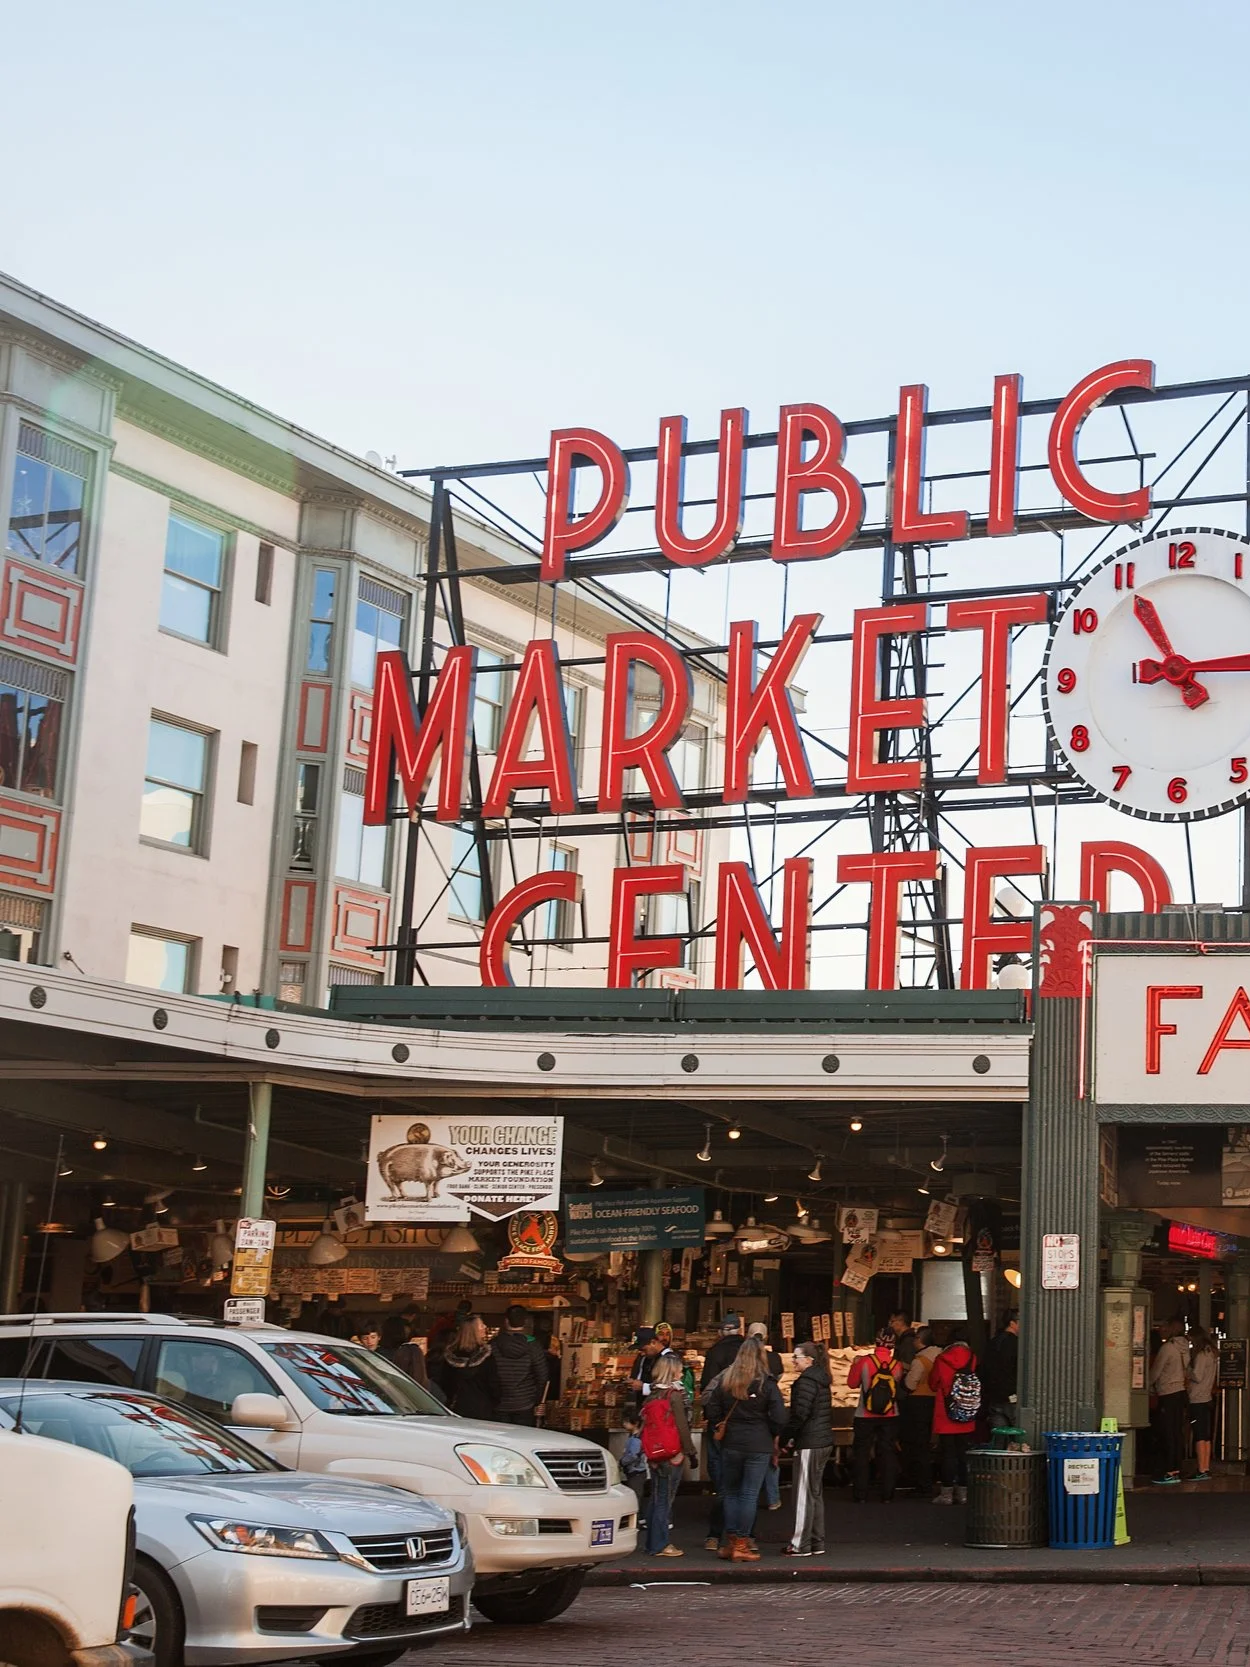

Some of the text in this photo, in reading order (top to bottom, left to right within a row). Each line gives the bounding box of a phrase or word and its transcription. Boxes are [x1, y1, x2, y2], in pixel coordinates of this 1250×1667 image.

[540, 359, 1156, 582] PUBLIC
[1168, 542, 1197, 570] 12
[1234, 553, 1243, 579] 1
[1114, 562, 1135, 590] 11
[1073, 608, 1098, 635] 10
[1057, 668, 1077, 694] 9
[363, 593, 1056, 826] MARKET
[1070, 725, 1090, 752] 8
[1112, 765, 1132, 792] 7
[1229, 757, 1248, 783] 5
[1167, 778, 1187, 803] 6
[448, 1125, 557, 1146] YOUR CHANGE
[466, 1147, 557, 1156] CHANGES LIVES!
[464, 1195, 537, 1203] DONATE HERE!
[595, 1205, 699, 1218] OCEAN-FRIENDLY SEAFOOD
[1048, 1250, 1075, 1259] STOPS
